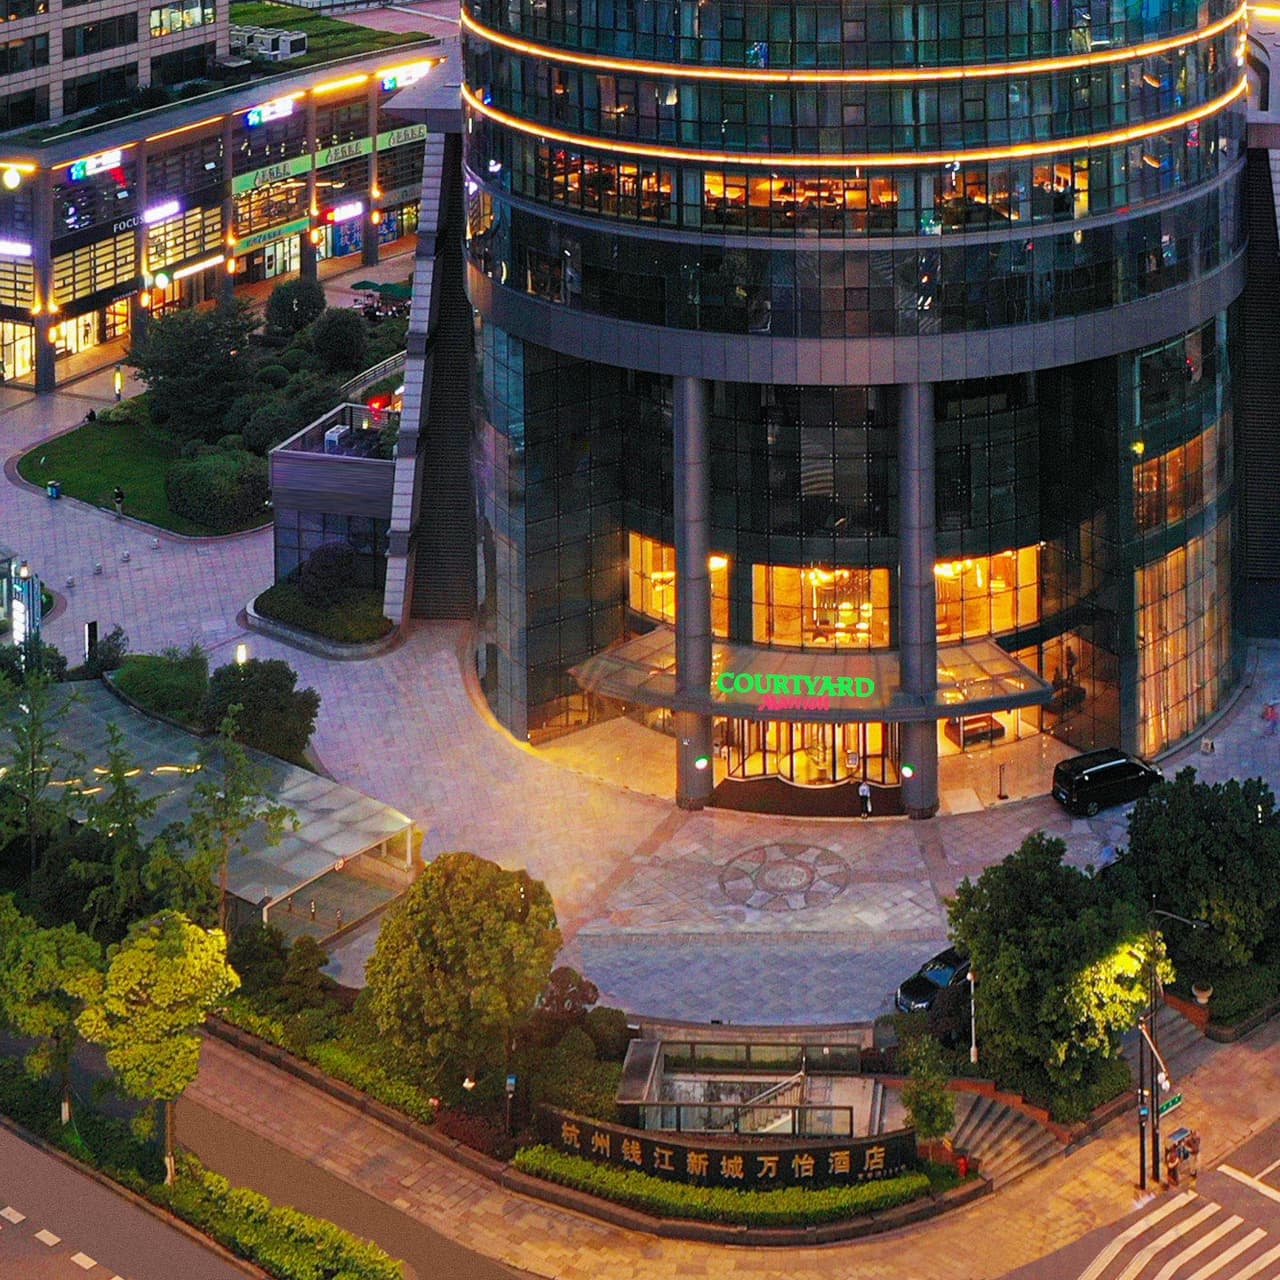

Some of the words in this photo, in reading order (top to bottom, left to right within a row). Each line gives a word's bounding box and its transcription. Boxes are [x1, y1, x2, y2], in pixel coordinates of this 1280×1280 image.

[113, 215, 146, 233] FOCUS
[716, 671, 876, 698] COURTYARD
[560, 1120, 888, 1180] 杭州钱江新城万怡酒店
